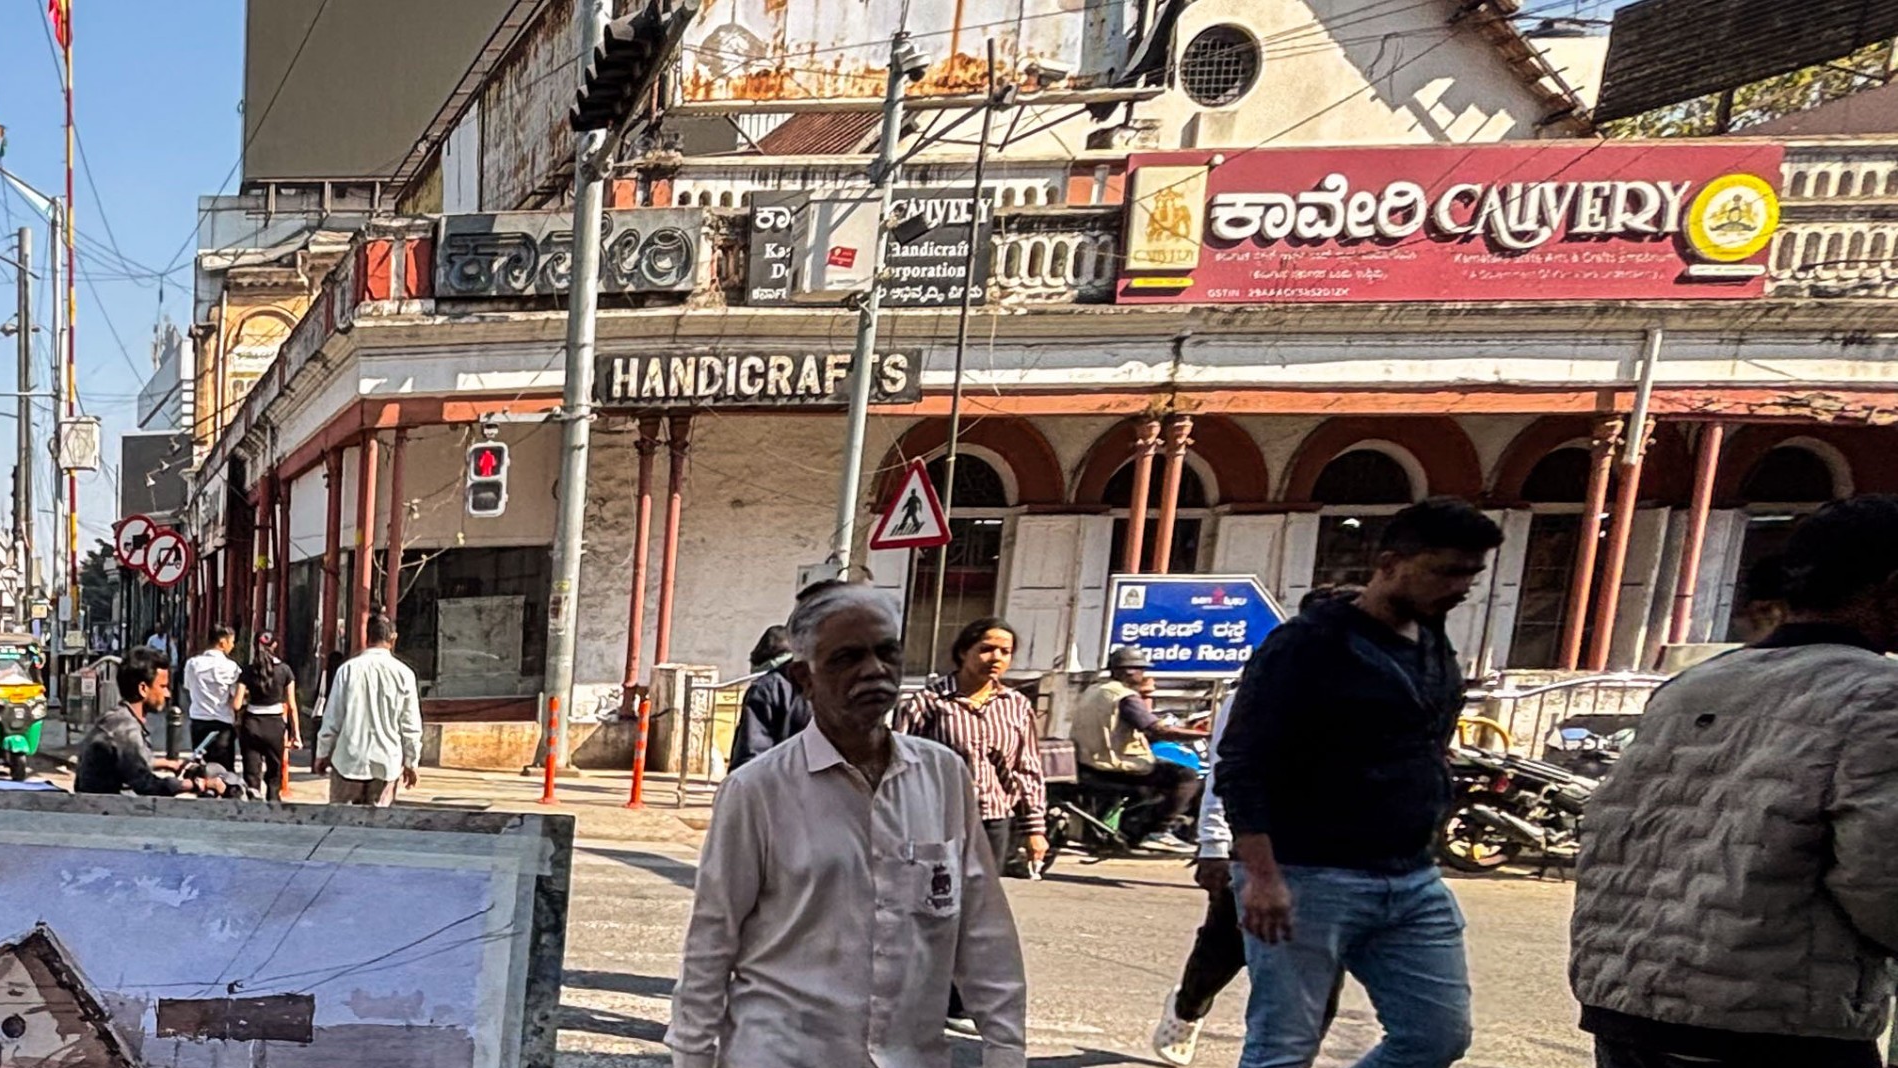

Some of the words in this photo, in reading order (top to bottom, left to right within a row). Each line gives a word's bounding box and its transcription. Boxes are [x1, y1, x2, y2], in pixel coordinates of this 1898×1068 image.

[1211, 173, 1427, 240] ಕಾವೇರಿ
[1433, 180, 1692, 250] CAUVERY
[612, 353, 909, 399] HANDICRAFS
[1197, 644, 1253, 661] Road
